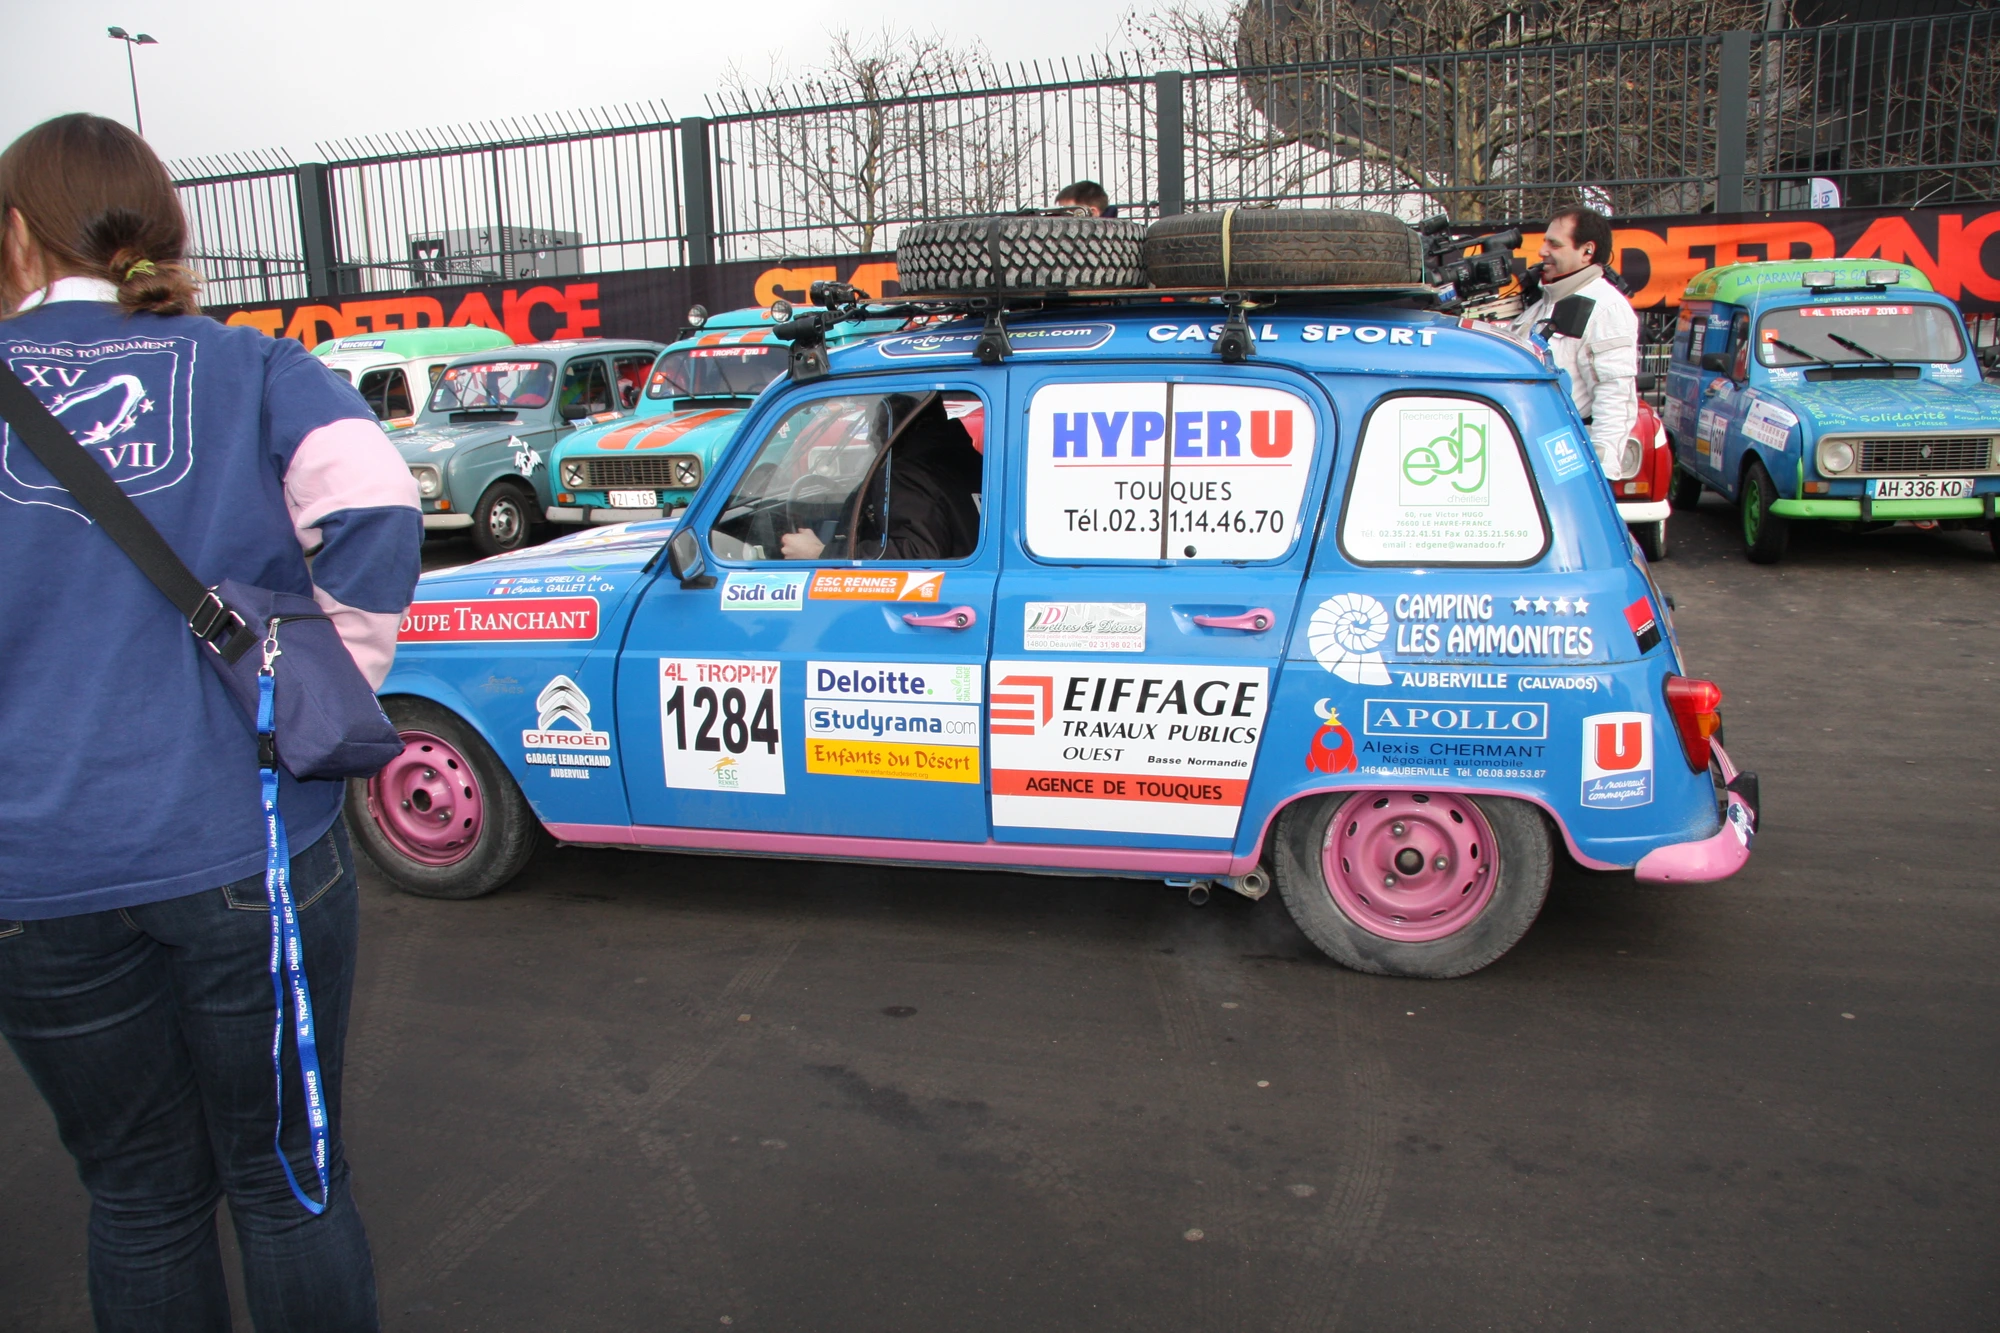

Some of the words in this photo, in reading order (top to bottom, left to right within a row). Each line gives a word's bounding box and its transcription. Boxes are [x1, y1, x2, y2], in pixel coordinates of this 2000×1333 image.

[1831, 308, 1869, 316] TROPHY
[1876, 307, 1898, 315] 2010
[341, 340, 384, 349] MICHELIN
[1148, 324, 1278, 344] CASL
[1303, 325, 1438, 347] SPORT
[10, 345, 74, 358] OVALIES
[76, 341, 177, 358] TOURNAMENT
[712, 348, 740, 357] TROPHY
[22, 365, 87, 387] XV
[1403, 412, 1454, 421] Recherches
[1818, 419, 1846, 427] Funky
[1860, 411, 1947, 424] Solidarité
[1052, 410, 1242, 458] HYPER
[1250, 410, 1293, 458] U
[100, 443, 157, 469] VII
[1402, 412, 1487, 494] edg
[1554, 439, 1574, 457] 4L
[1114, 481, 1233, 505] TOUQUES
[1878, 481, 1962, 497] AH-336-KD
[1446, 494, 1488, 504] d'héritiers
[1404, 511, 1417, 519] 60,
[1435, 511, 1459, 519] Victor
[1461, 511, 1484, 519] HUGO
[1360, 530, 1376, 538] Tél.
[1378, 530, 1441, 538] 02.35.22.41.51
[1444, 530, 1461, 538] Fax
[1464, 530, 1528, 538] 02.35.21.56.90
[1382, 541, 1406, 549] email
[1415, 541, 1506, 550] edgene@wanadoo.fr
[544, 576, 575, 584] GRIEU
[588, 574, 603, 582] A+
[546, 583, 586, 593] GALLET
[816, 577, 842, 587] ESC
[844, 577, 898, 588] RENNES
[726, 584, 767, 602] Sidi
[771, 584, 798, 602] ali
[1395, 593, 1493, 621] CAMPING
[397, 614, 451, 633] OUPE
[454, 607, 590, 632] TRANCHANT
[1081, 621, 1097, 633] &
[1098, 619, 1143, 634] Décors
[1395, 624, 1442, 655] LES
[1447, 625, 1594, 657] AMMONITES
[664, 662, 689, 683] 4L
[696, 663, 778, 685] TROPHY
[955, 666, 963, 678] ECO
[963, 666, 971, 702] CHALLENGE
[1401, 672, 1507, 689] AUBERVILLE
[1517, 675, 1599, 693] (CALVADOS)
[1063, 676, 1259, 717] EIFFAGE
[666, 685, 779, 755] 1284
[814, 707, 976, 737] Studyrama.com
[1373, 707, 1539, 732] APOLLO
[1063, 721, 1158, 740] TRAVAUX
[1168, 725, 1257, 744] PUBLICS
[1063, 746, 1125, 762] OUEST
[1362, 741, 1419, 755] Alexis
[1430, 743, 1546, 757] CHERMANT
[1594, 722, 1643, 771] U
[525, 753, 557, 765] GARAGE
[558, 754, 611, 768] LEMARCHAND
[814, 744, 881, 767] Enfants
[888, 751, 910, 767] du
[916, 750, 970, 771] Désert
[1148, 756, 1182, 765] Basse
[1187, 757, 1248, 768] Normandie
[1382, 755, 1447, 766] Négociant
[1453, 758, 1524, 768] automobile
[550, 768, 589, 780] AUBERVILLE
[717, 768, 738, 781] ESC
[855, 767, 929, 780] www.enfantsdudesert.org
[1392, 767, 1450, 776] AUBERVILLE
[1456, 767, 1472, 777] Tél.
[1476, 769, 1546, 778] 06.08.99.53.87
[1026, 777, 1094, 793] AGENCE
[1104, 780, 1126, 795] DE
[1136, 781, 1222, 800] TOUQUES
[1605, 777, 1646, 790] nouveaux
[1588, 786, 1647, 801] commerçants
[267, 868, 276, 903] Deloitte
[278, 867, 291, 904] RENNES
[284, 905, 294, 924] ESC
[271, 936, 280, 973] RENNES
[289, 936, 299, 971] Deloitte
[301, 1024, 309, 1037] 4L
[306, 1070, 320, 1107] RENNES
[312, 1108, 324, 1128] ESC
[316, 1138, 325, 1169] Deloitte
